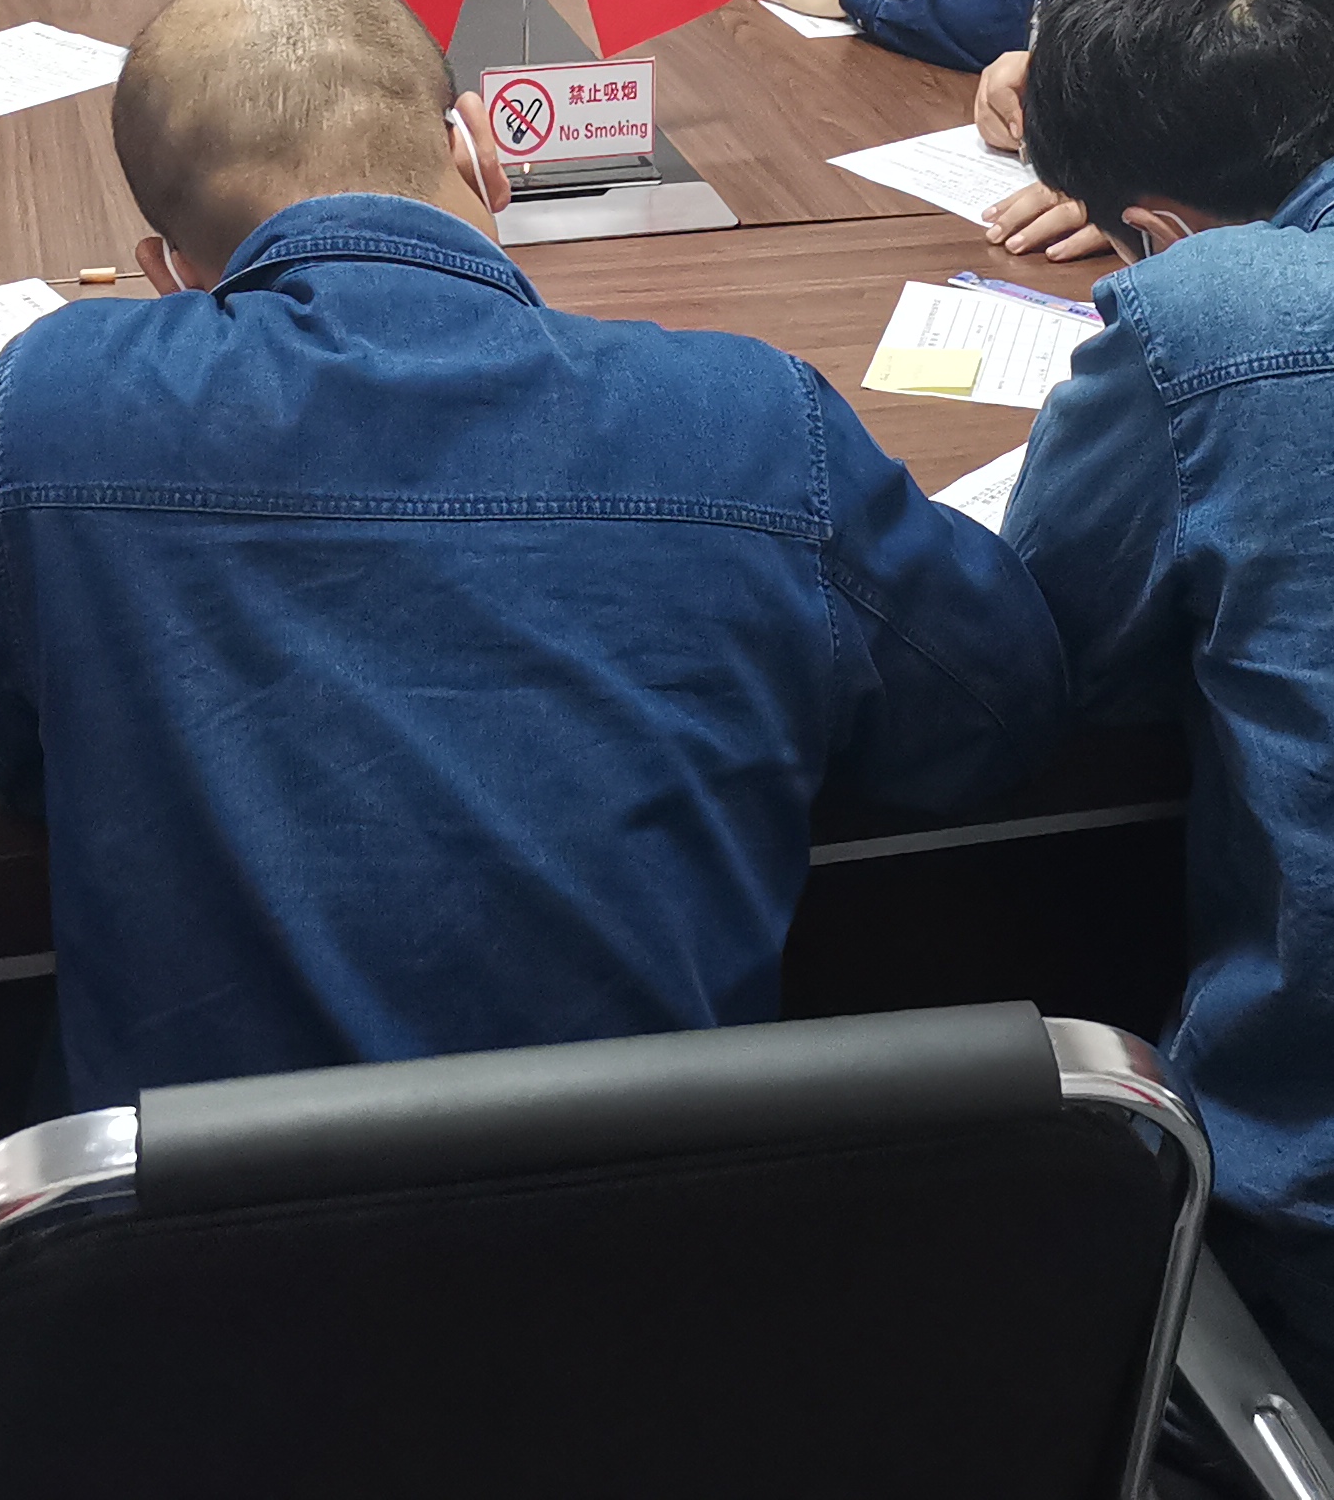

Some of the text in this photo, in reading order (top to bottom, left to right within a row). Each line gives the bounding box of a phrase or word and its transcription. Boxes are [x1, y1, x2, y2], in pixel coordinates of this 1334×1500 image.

[569, 81, 638, 105] 禁止吸烟
[559, 120, 648, 141] No Smoking
